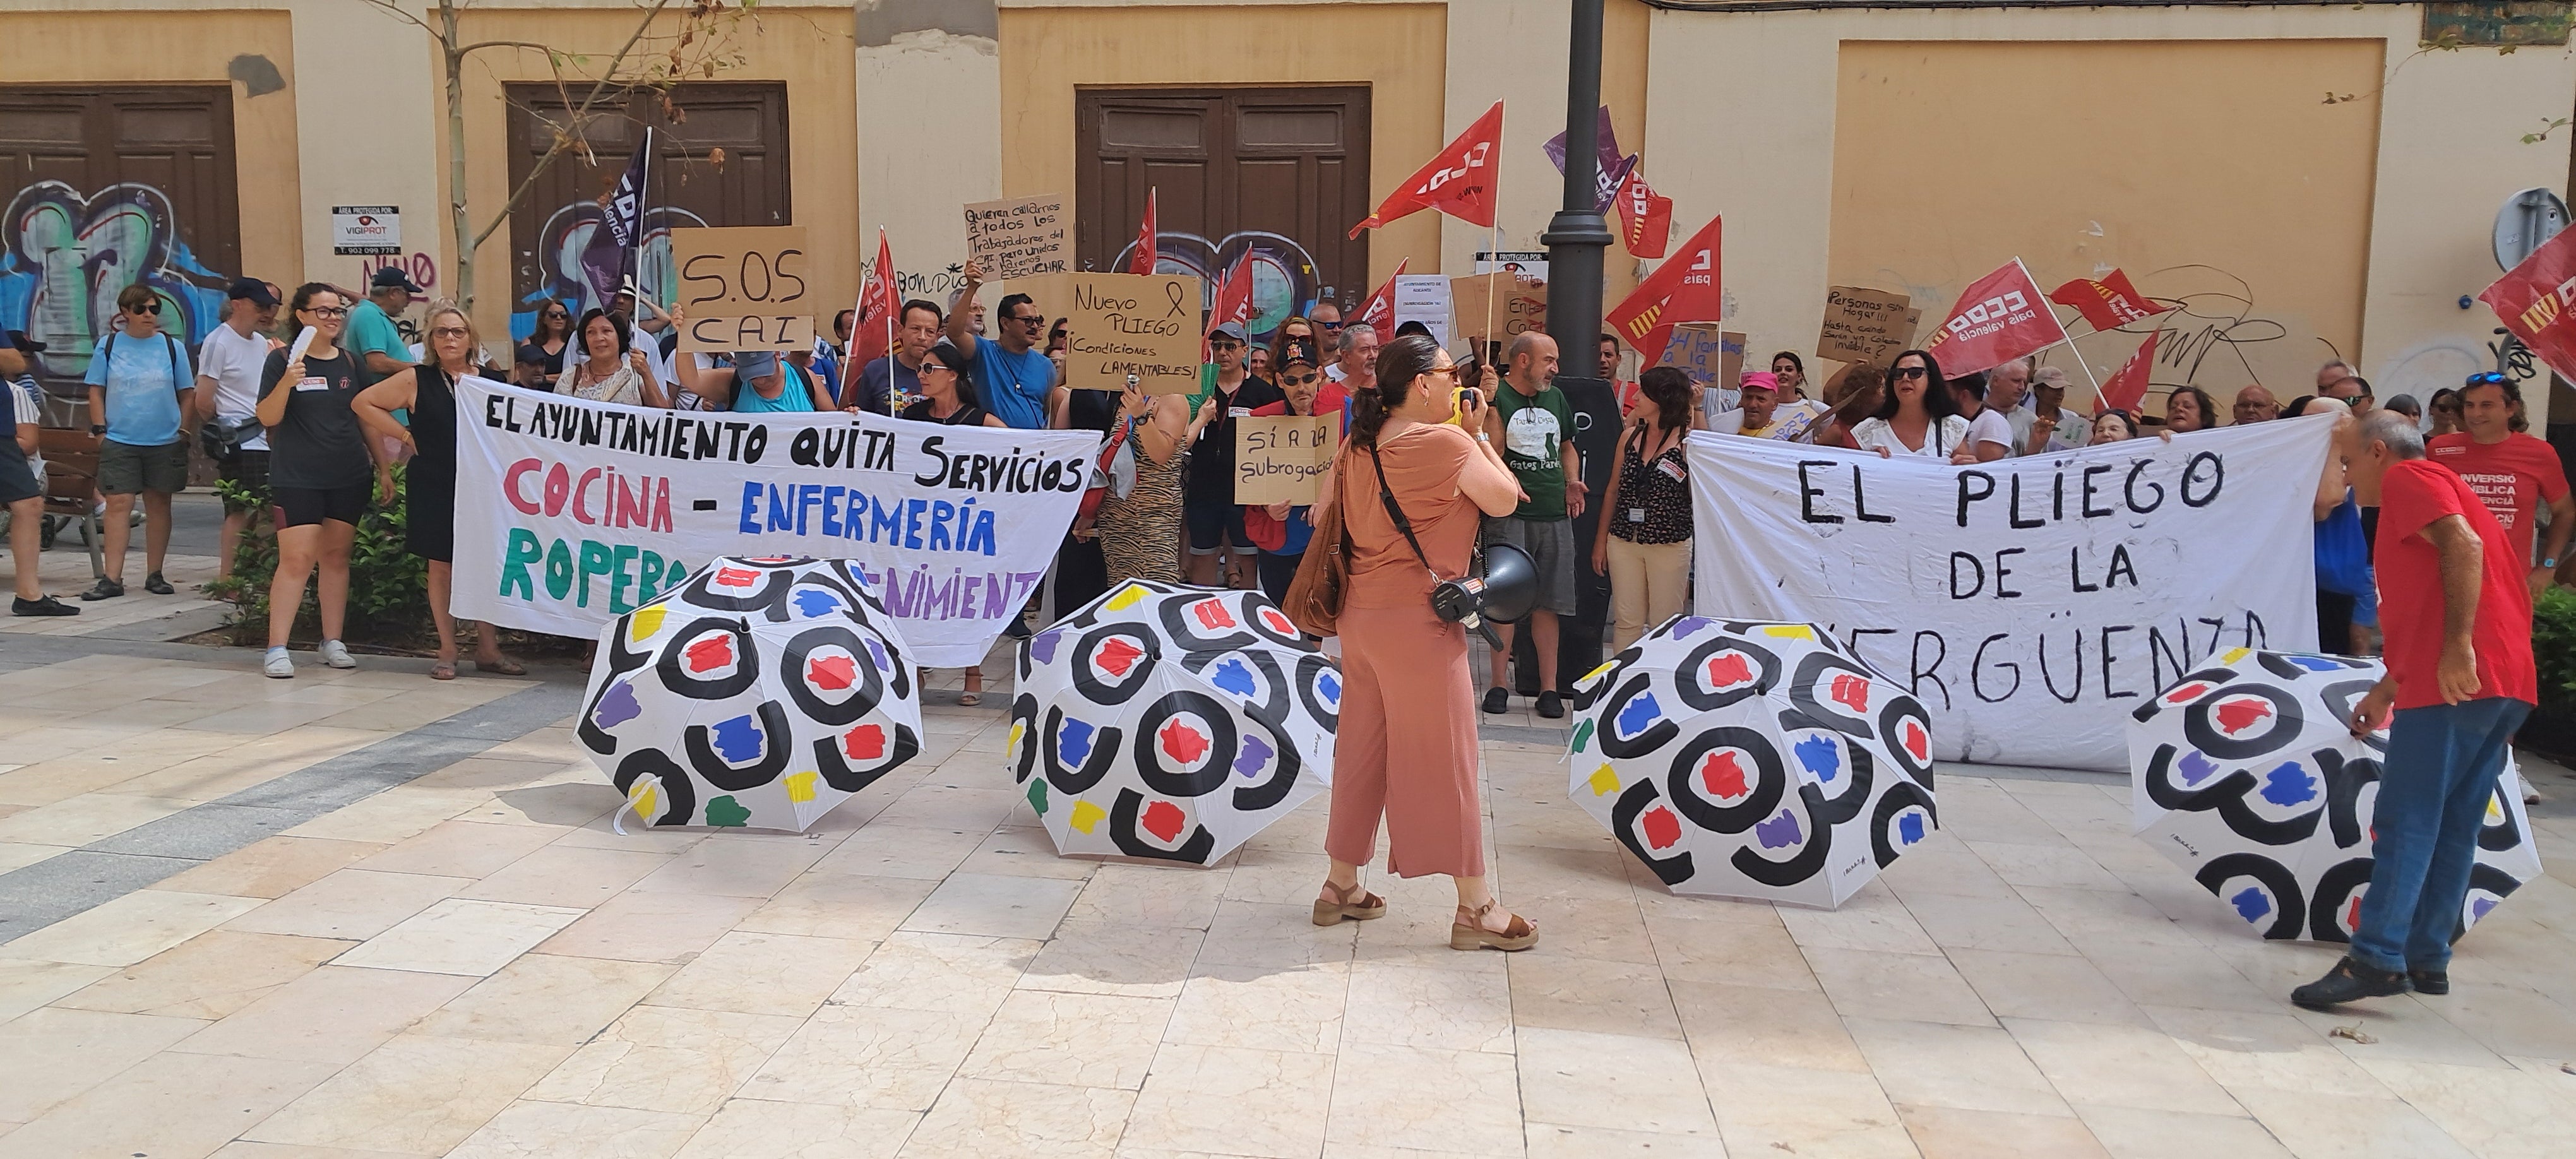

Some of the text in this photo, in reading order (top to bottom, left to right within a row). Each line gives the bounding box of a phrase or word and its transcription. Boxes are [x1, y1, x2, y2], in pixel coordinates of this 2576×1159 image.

[965, 209, 1009, 223] Quieren
[982, 219, 1024, 235] todos
[1049, 229, 1064, 239] del
[980, 265, 994, 273] os
[1000, 260, 1067, 280] ESCUCHAR
[1075, 283, 1136, 311] Nuevo
[692, 315, 797, 347] CAI
[1104, 313, 1179, 337] PLIEGO
[1824, 320, 1853, 333] Hasta
[1100, 361, 1197, 380] LAMENTABLES!
[486, 395, 524, 433] EL
[1510, 460, 1537, 471] Gatos
[1798, 460, 1895, 524] EL
[739, 481, 996, 556] ENFERMERÍA
[1950, 544, 2138, 598] DE LA
